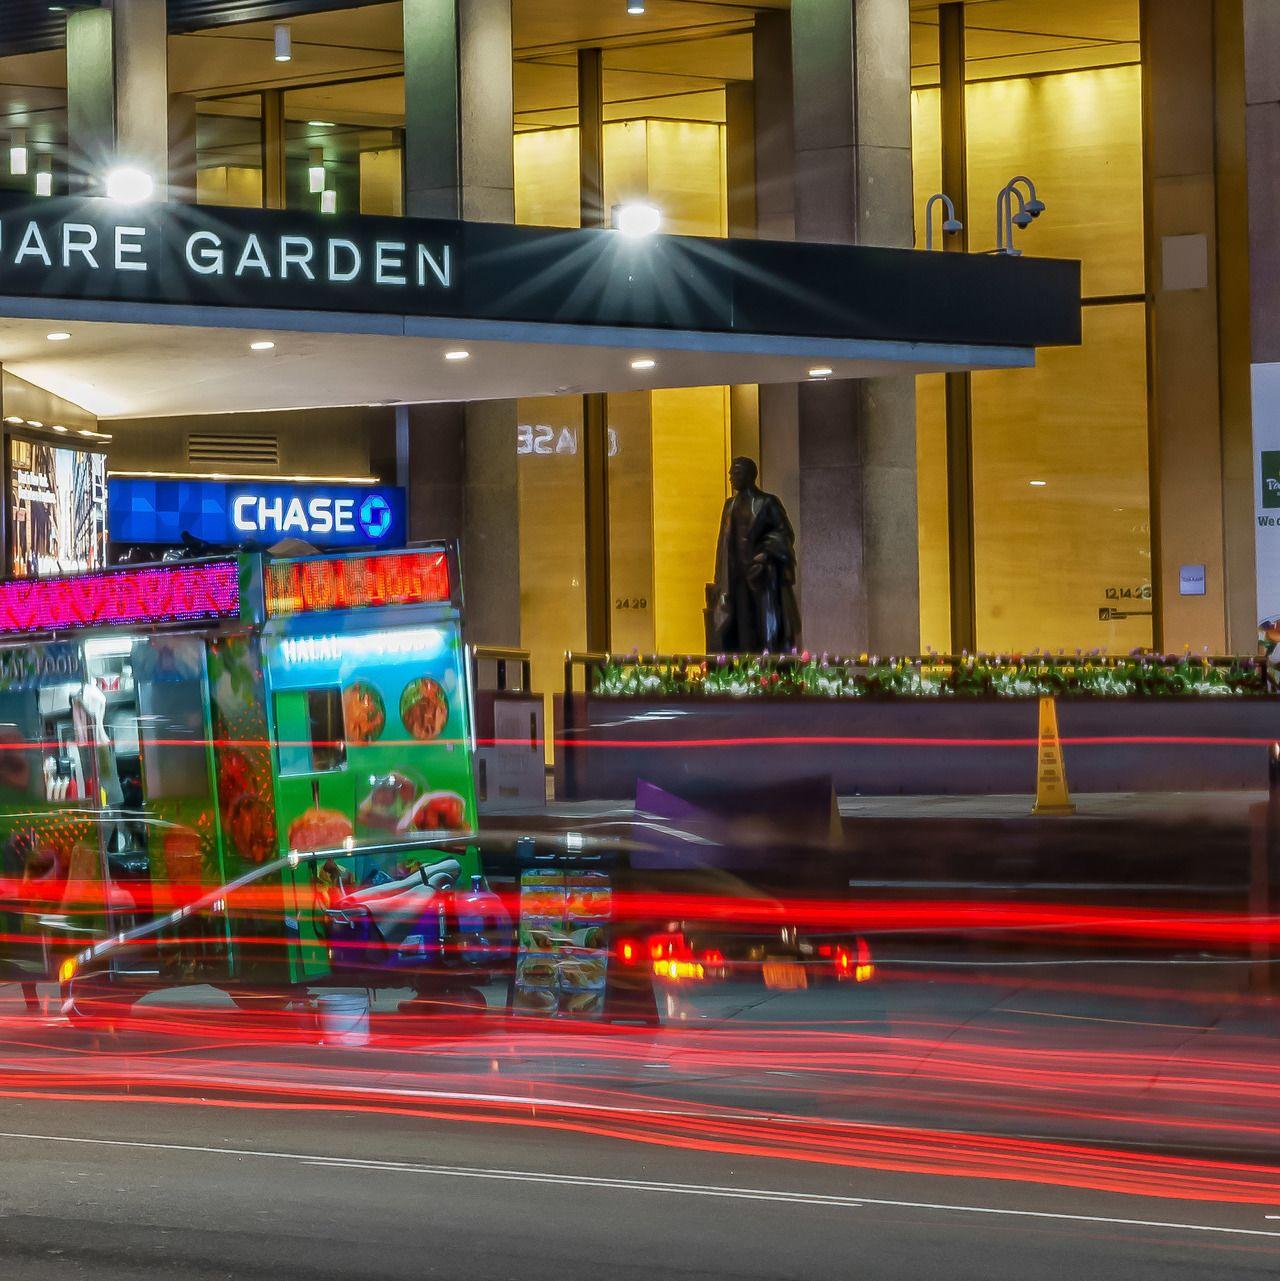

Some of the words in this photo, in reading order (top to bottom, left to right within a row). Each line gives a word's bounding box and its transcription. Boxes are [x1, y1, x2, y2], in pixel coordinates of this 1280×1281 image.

[185, 230, 452, 288] GARDEN
[233, 495, 357, 532] CHASE
[1258, 515, 1275, 527] We
